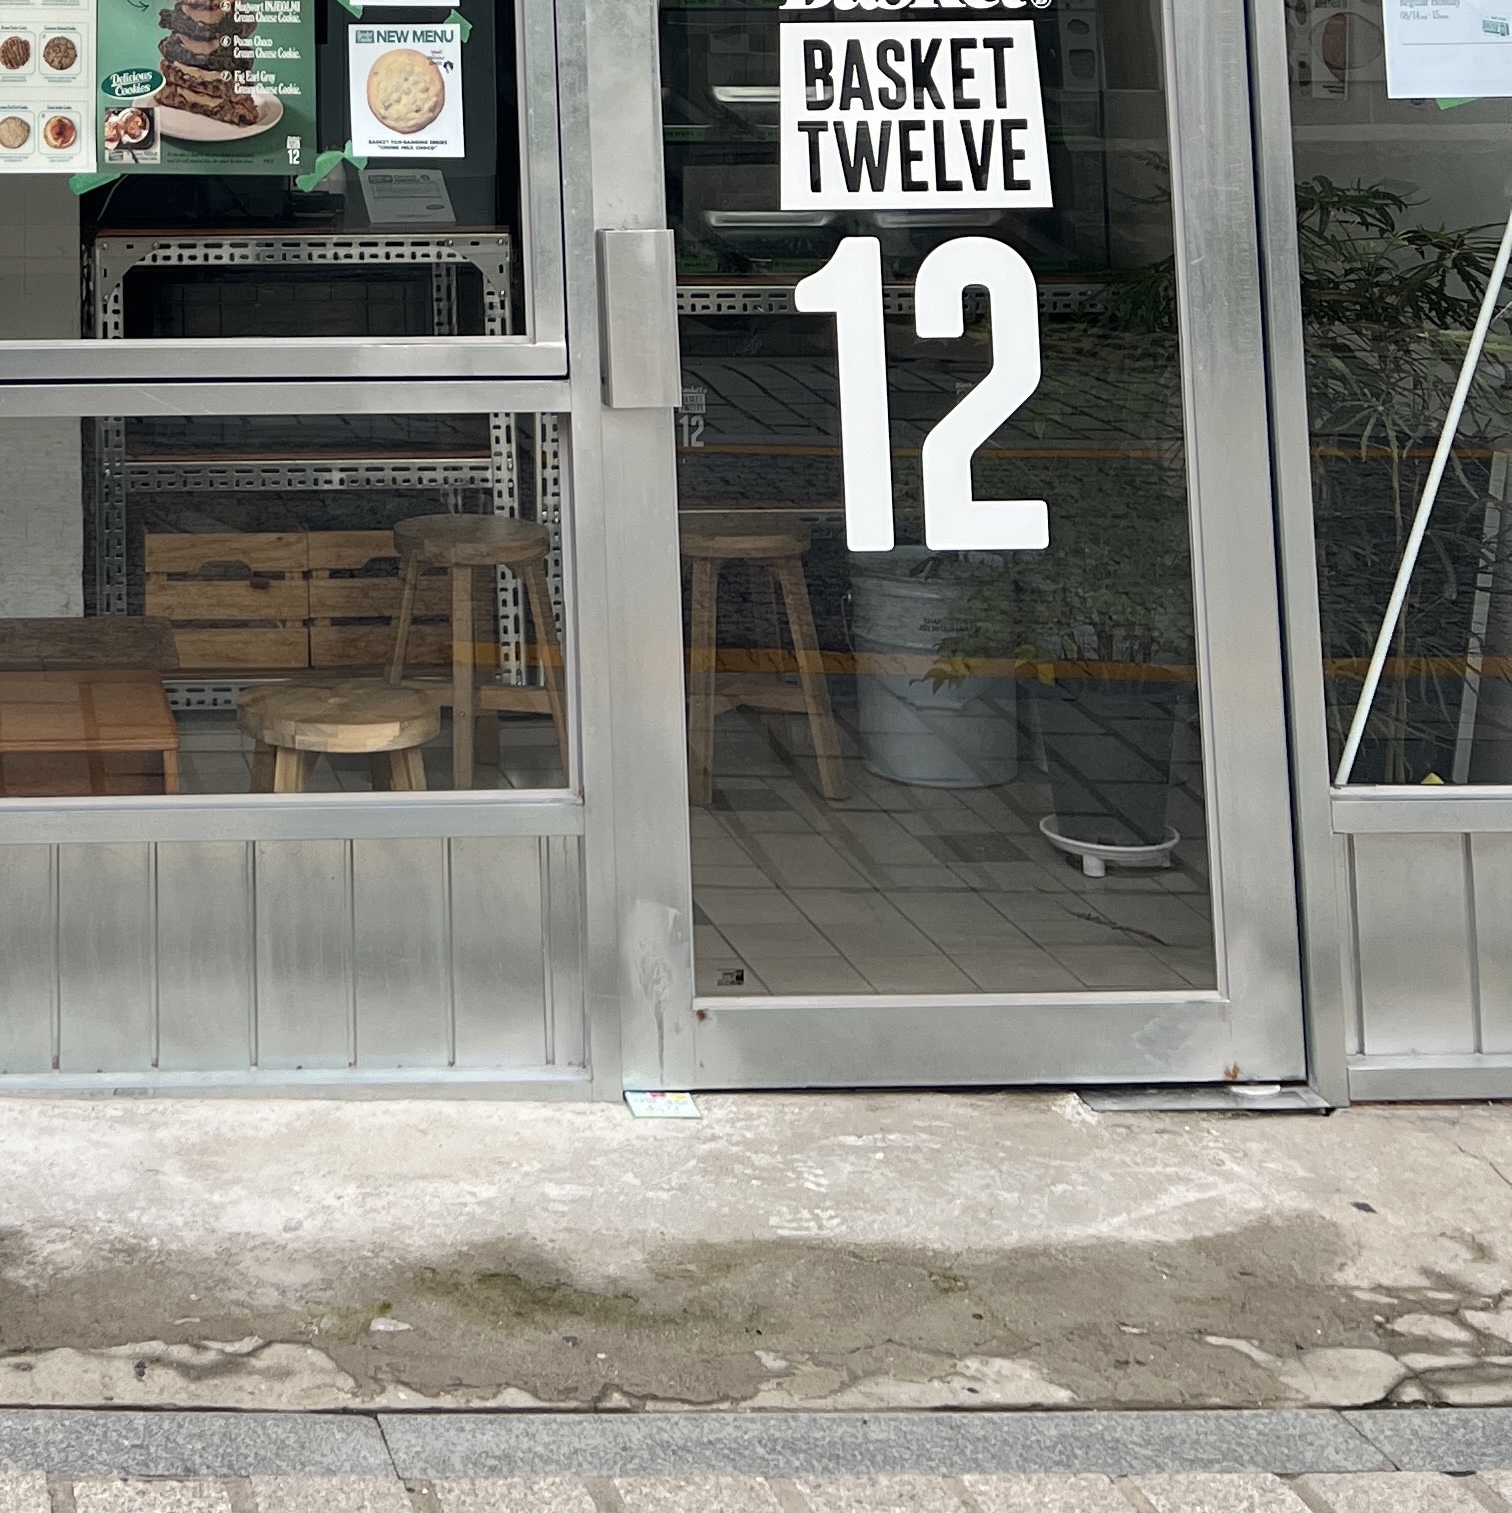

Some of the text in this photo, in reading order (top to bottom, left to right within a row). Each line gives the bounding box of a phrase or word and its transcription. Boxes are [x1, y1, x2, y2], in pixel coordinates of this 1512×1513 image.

[377, 30, 454, 44] NEW MENU
[110, 71, 153, 86] Delicious
[803, 37, 1014, 111] BASKET
[114, 82, 151, 96] Cookies
[288, 149, 300, 164] 12
[797, 119, 1031, 193] TWELVE
[794, 237, 1049, 551] 12
[679, 415, 704, 447] 12
